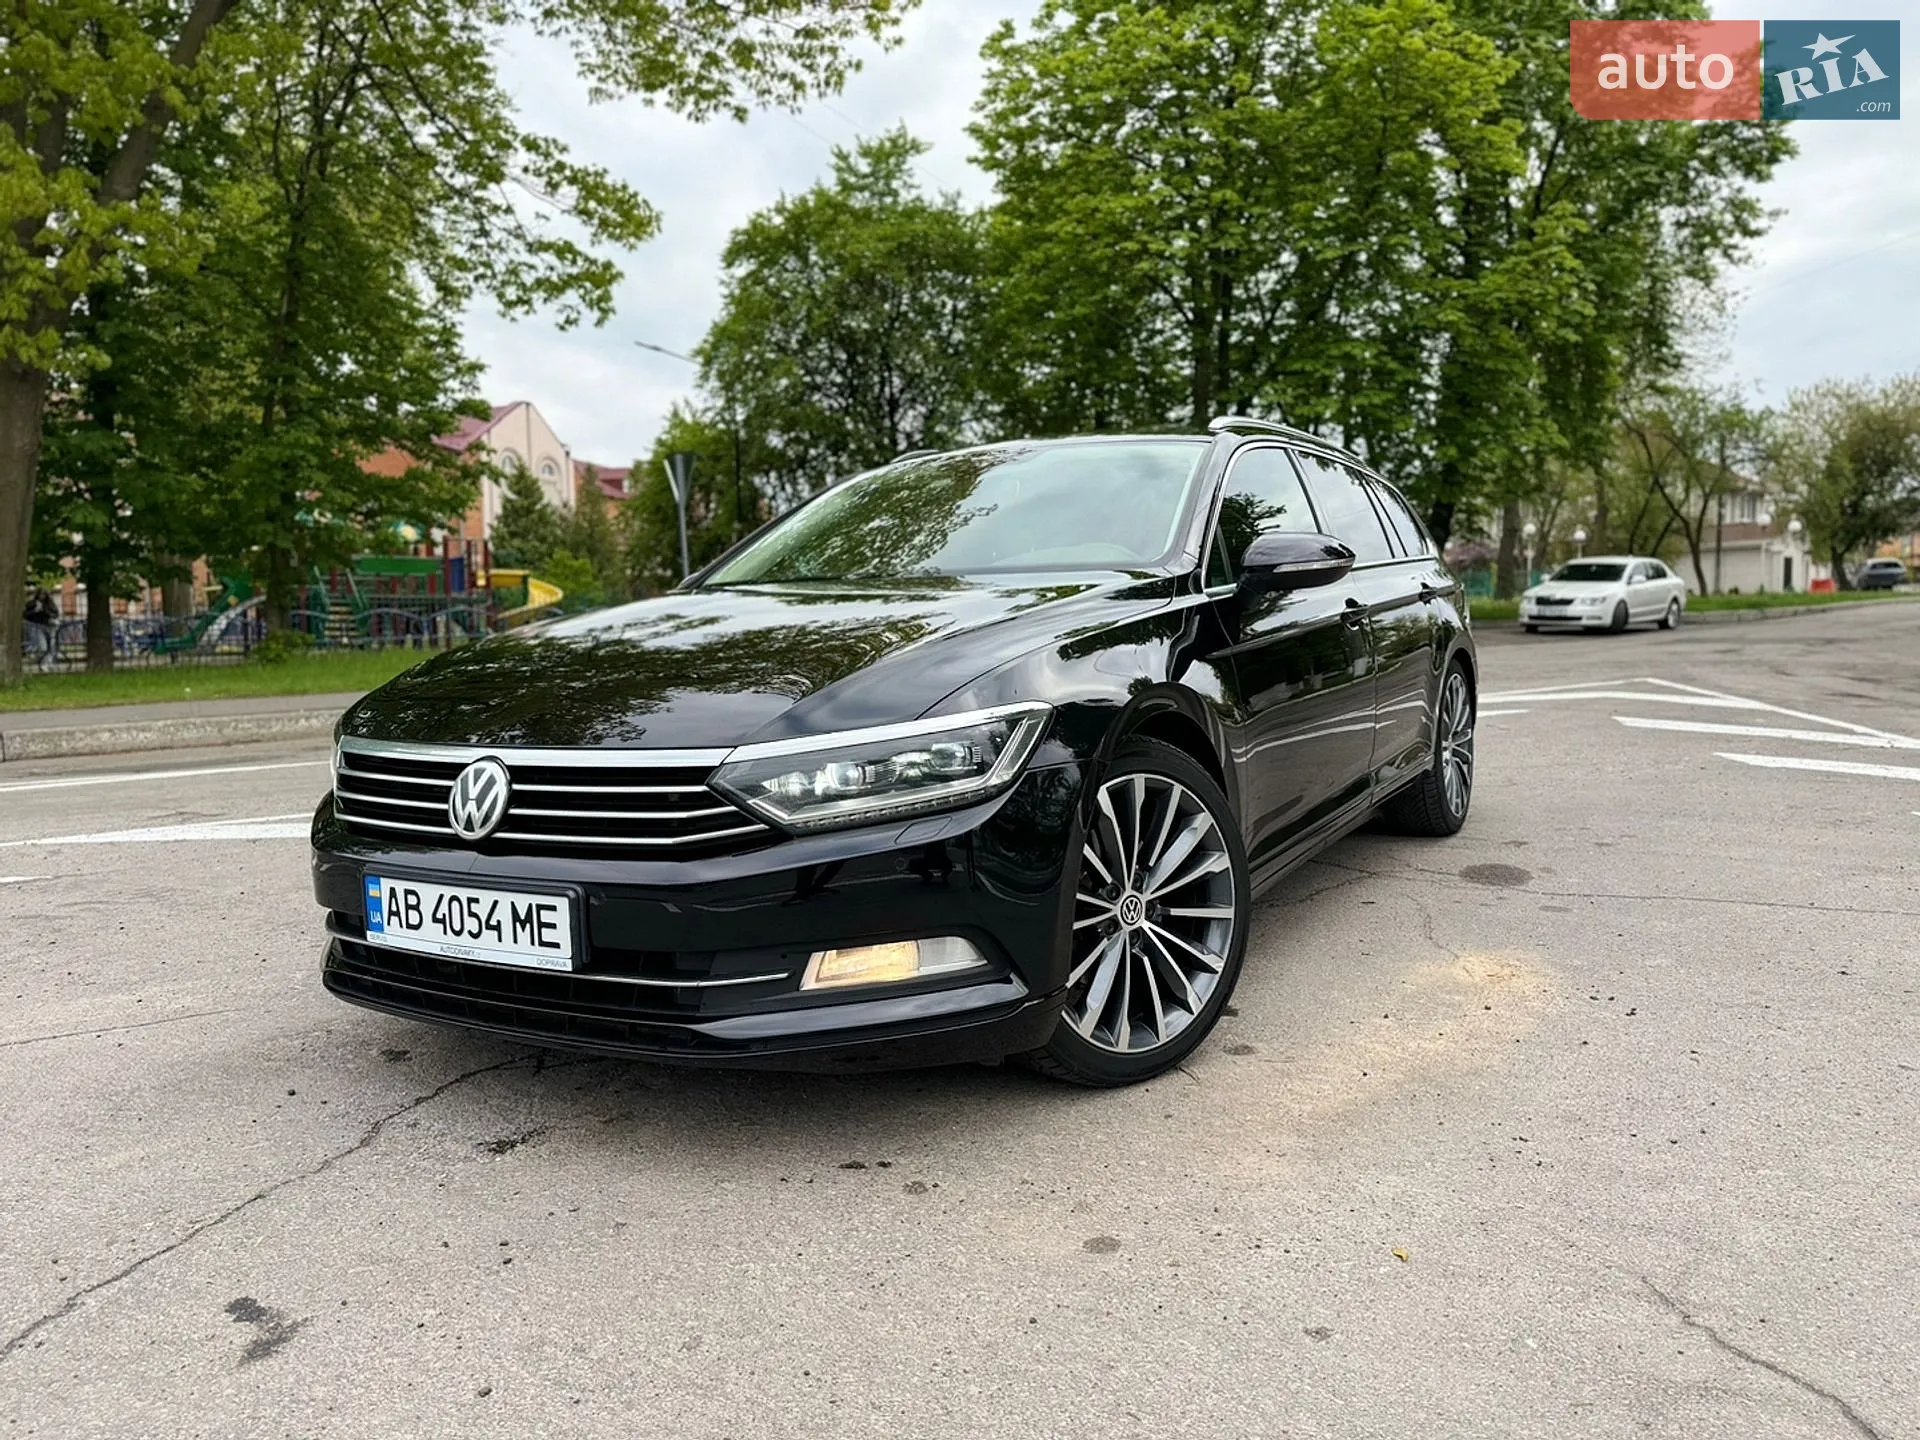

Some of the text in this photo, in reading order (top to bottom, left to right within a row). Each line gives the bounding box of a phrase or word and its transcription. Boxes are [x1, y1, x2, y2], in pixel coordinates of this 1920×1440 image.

[370, 910, 383, 924] UA
[387, 886, 561, 950] AB 4054 ME
